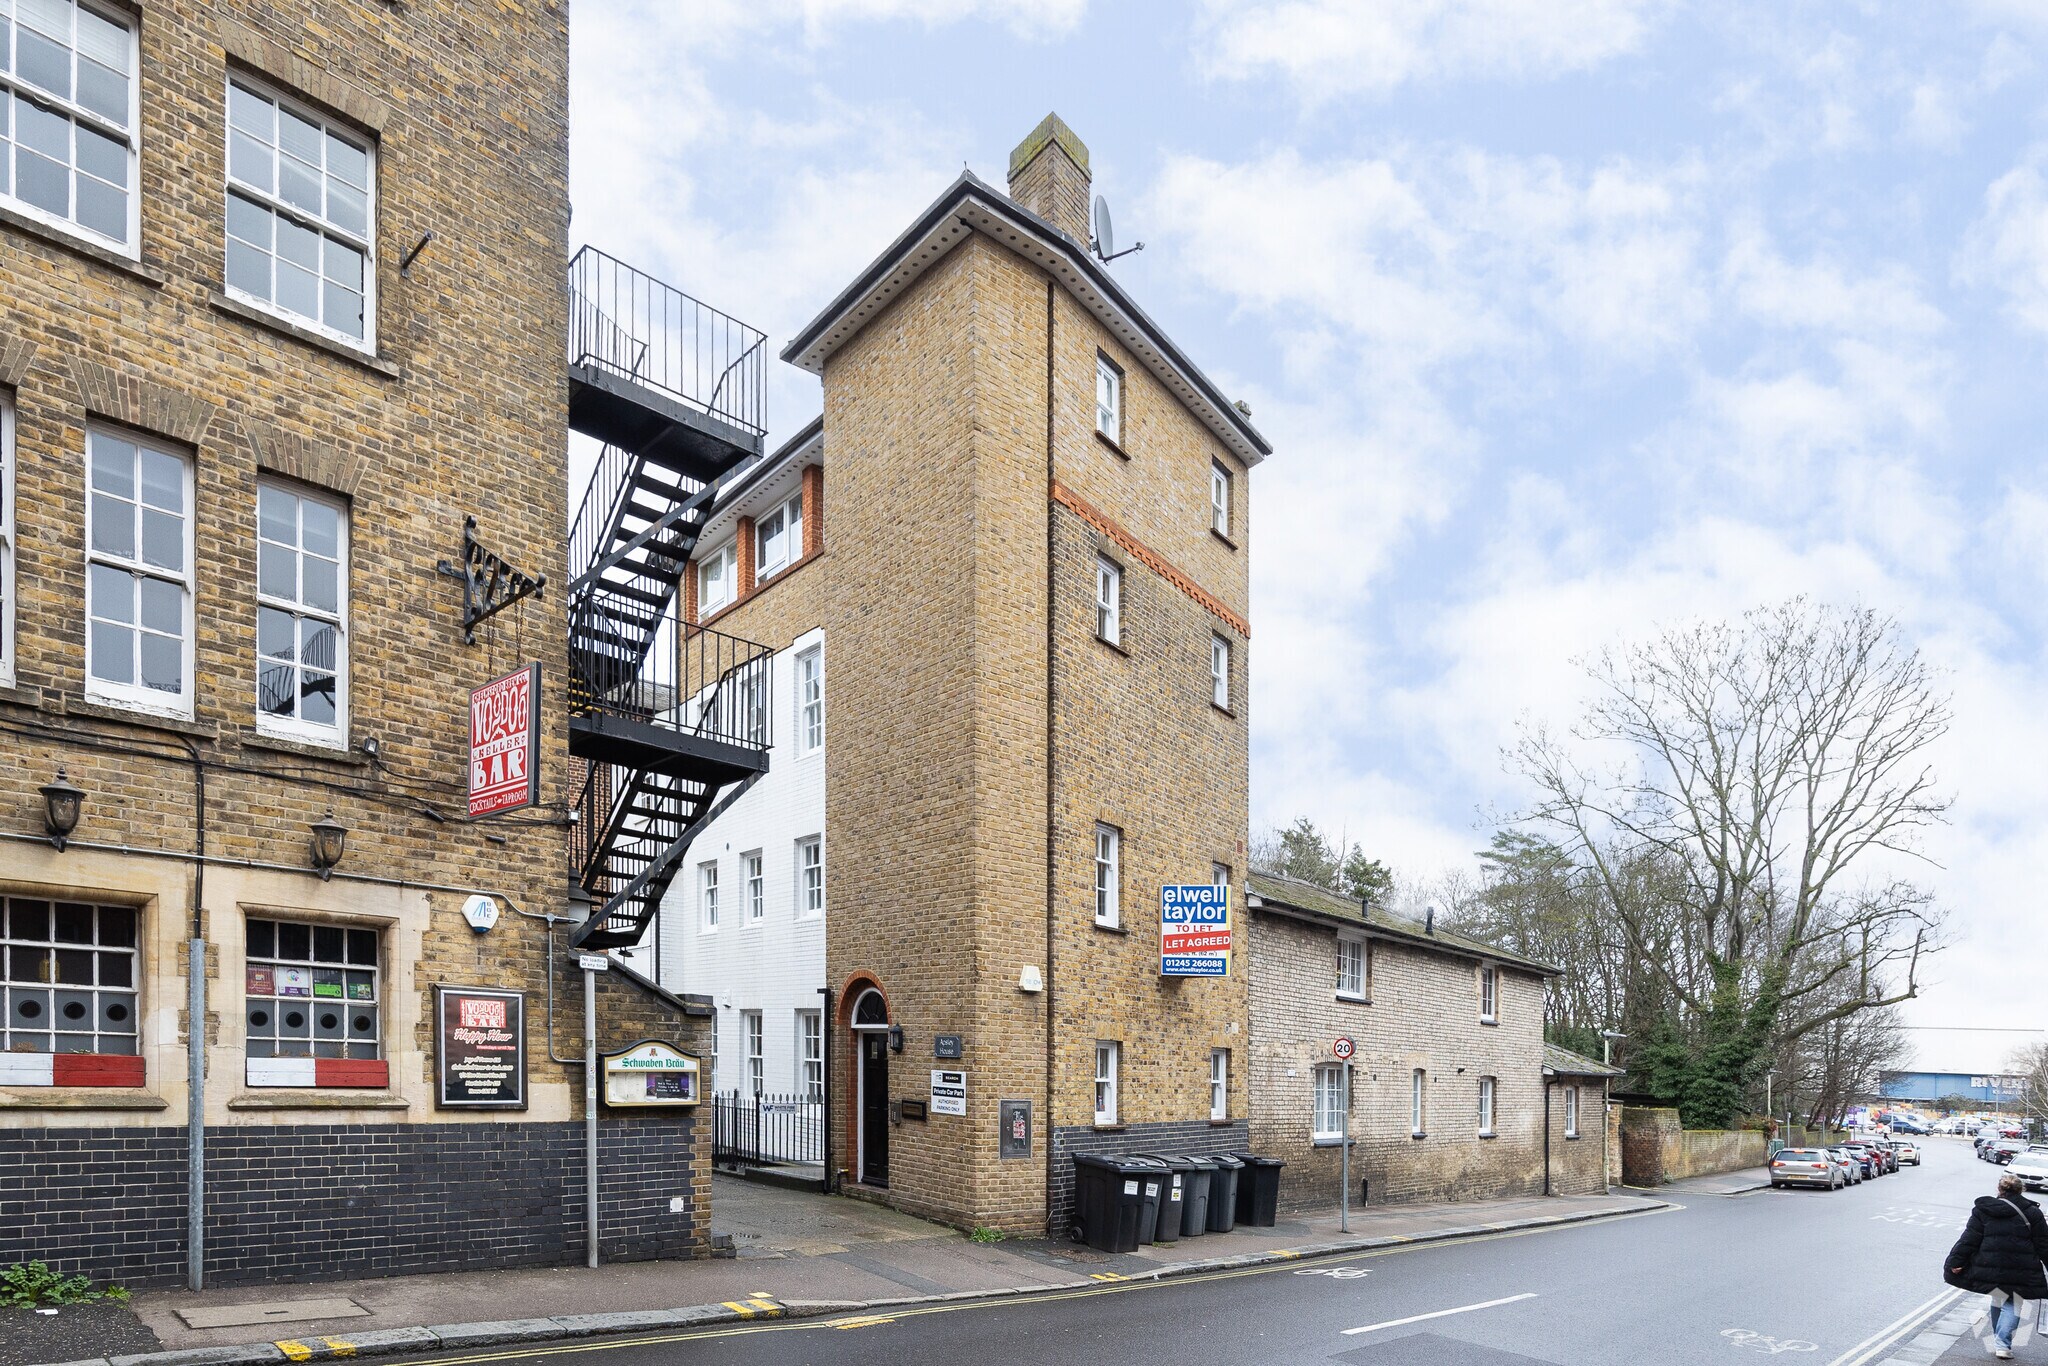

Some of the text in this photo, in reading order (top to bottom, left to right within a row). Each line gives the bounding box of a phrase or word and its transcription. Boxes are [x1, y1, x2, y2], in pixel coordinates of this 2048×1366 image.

[504, 676, 518, 690] BREW
[473, 685, 528, 745] VOODOO
[479, 736, 519, 759] KELLER
[473, 748, 525, 790] BAR
[469, 788, 528, 813] COCKTAILS TAPROOM
[1163, 886, 1225, 903] elwell
[1163, 902, 1226, 923] taylor
[1165, 936, 1230, 949] LET AGREED
[1165, 959, 1223, 968] 01245 266088
[467, 1016, 500, 1027] BAR
[453, 1028, 513, 1044] Happy Hour
[940, 1047, 954, 1055] House
[1336, 1044, 1351, 1053] 20
[622, 1057, 685, 1068] Schwaben Bräu
[933, 1087, 947, 1095] Private
